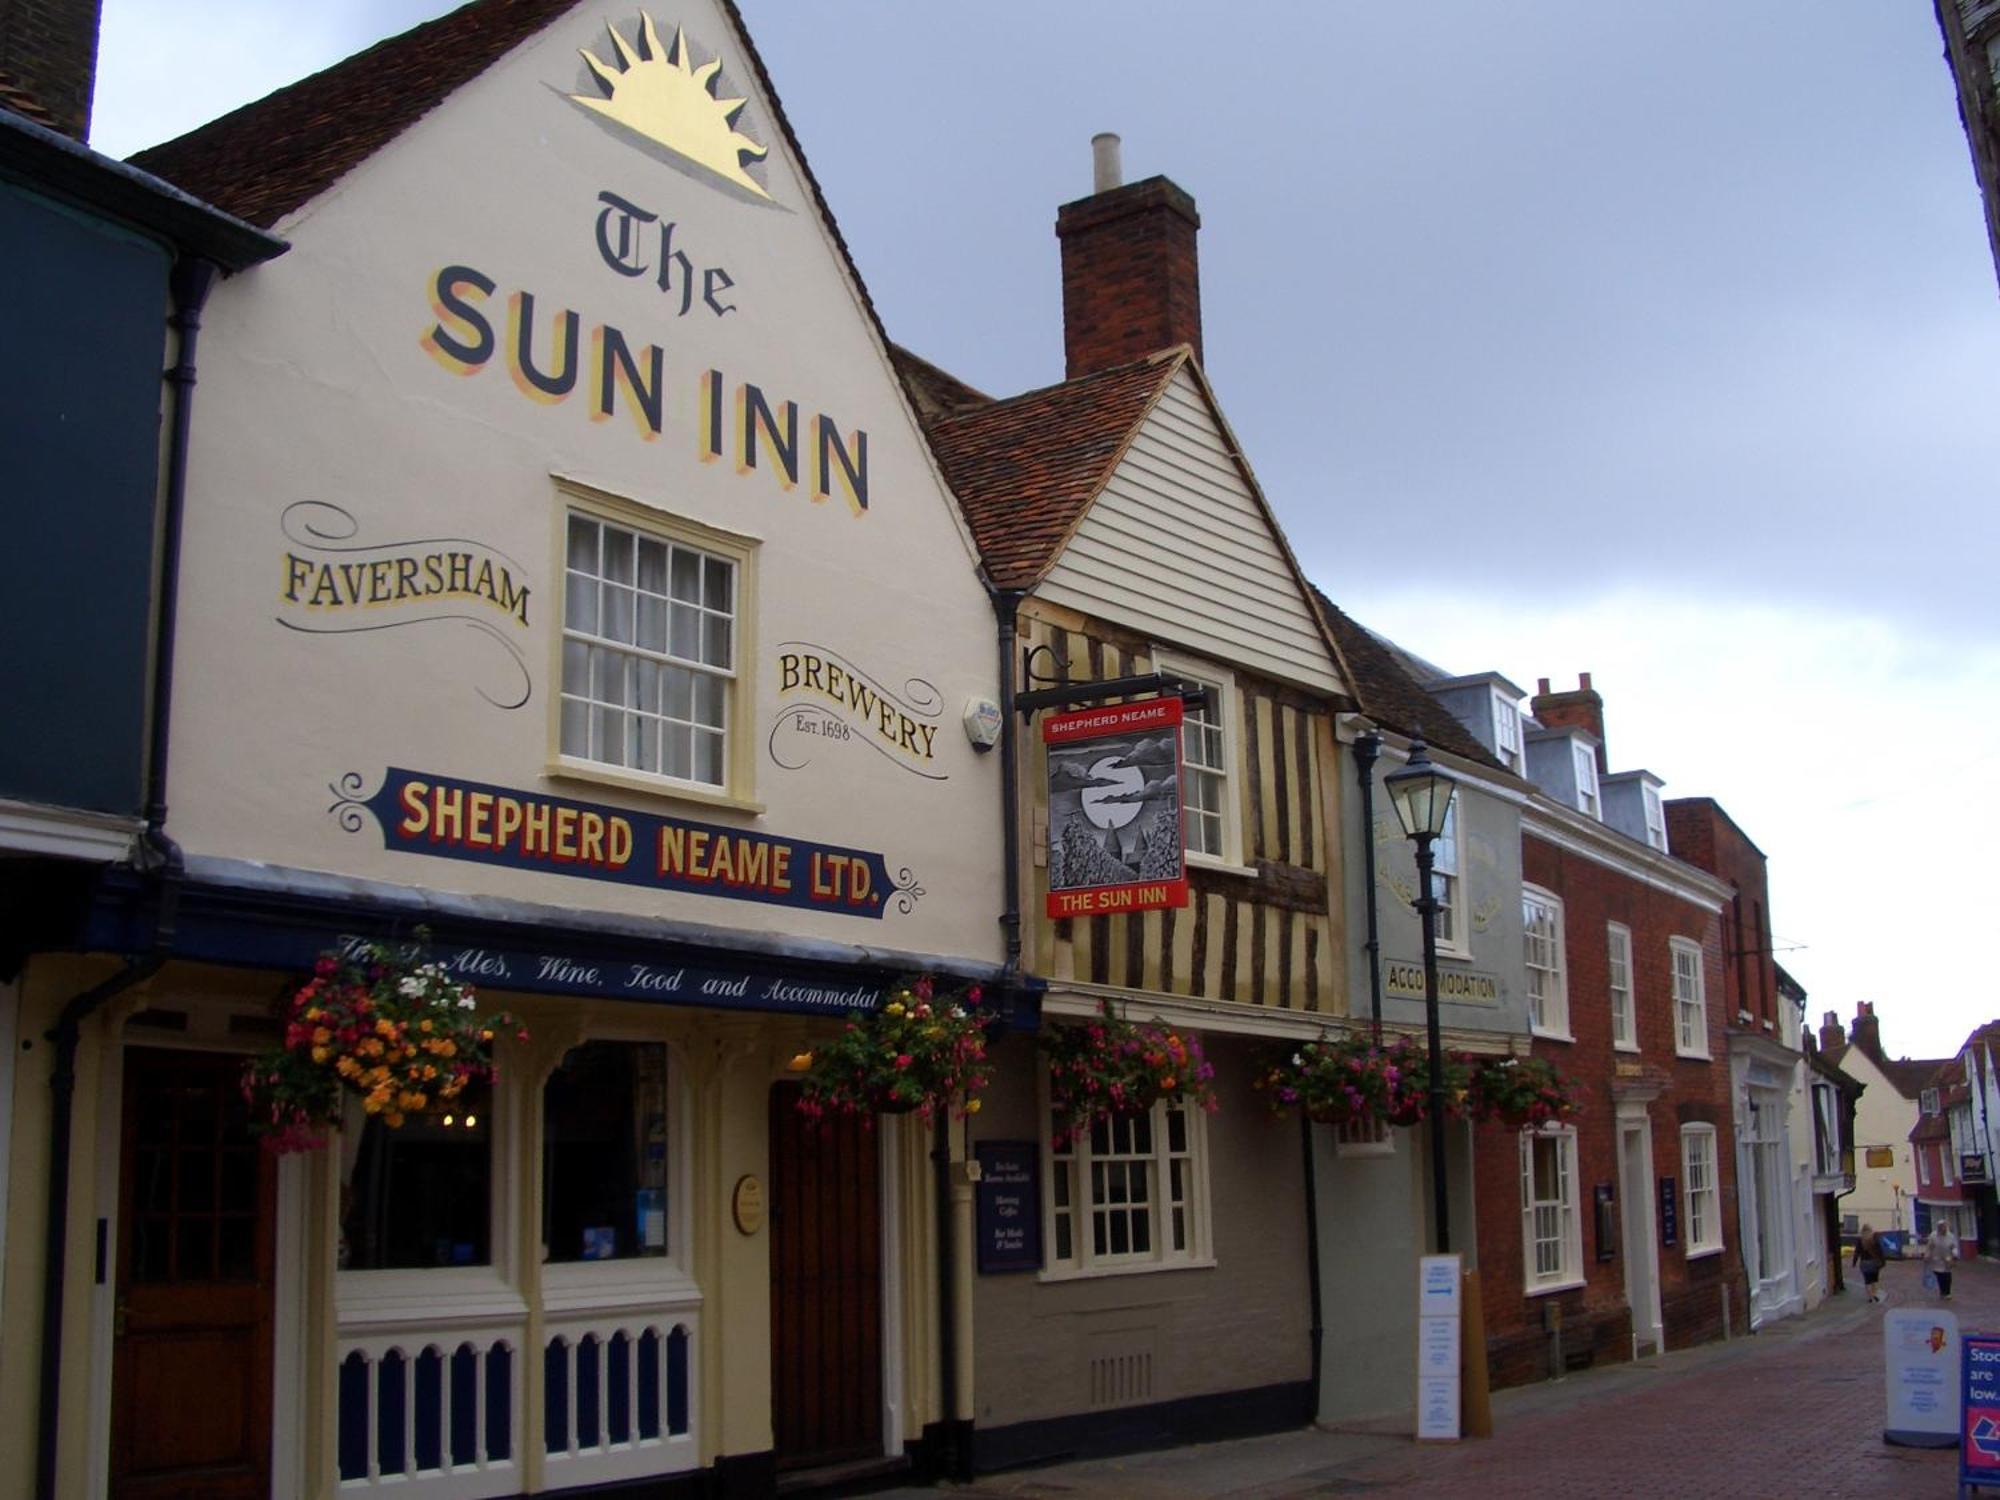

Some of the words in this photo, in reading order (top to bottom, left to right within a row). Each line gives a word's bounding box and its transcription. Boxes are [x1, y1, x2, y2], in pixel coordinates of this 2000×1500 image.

[595, 190, 737, 317] The
[420, 265, 664, 441] SUN
[699, 368, 869, 518] INN
[284, 552, 532, 626] FAVERSHAM
[779, 654, 938, 763] BREWERY
[822, 720, 850, 741] 1698
[1051, 714, 1118, 733] SHEPHERD
[1121, 707, 1166, 723] NEAME
[401, 781, 633, 867] SHEPHERD
[658, 825, 791, 891] NEAME
[811, 851, 879, 904] LTD.
[1060, 893, 1094, 911] THE
[1099, 890, 1132, 908] SUN
[1138, 886, 1167, 904] INN
[624, 964, 685, 992] Food
[700, 976, 750, 998] and
[761, 979, 879, 1009] Accommodat
[1388, 966, 1496, 998] ACCOMODATION
[1970, 1370, 1994, 1381] are
